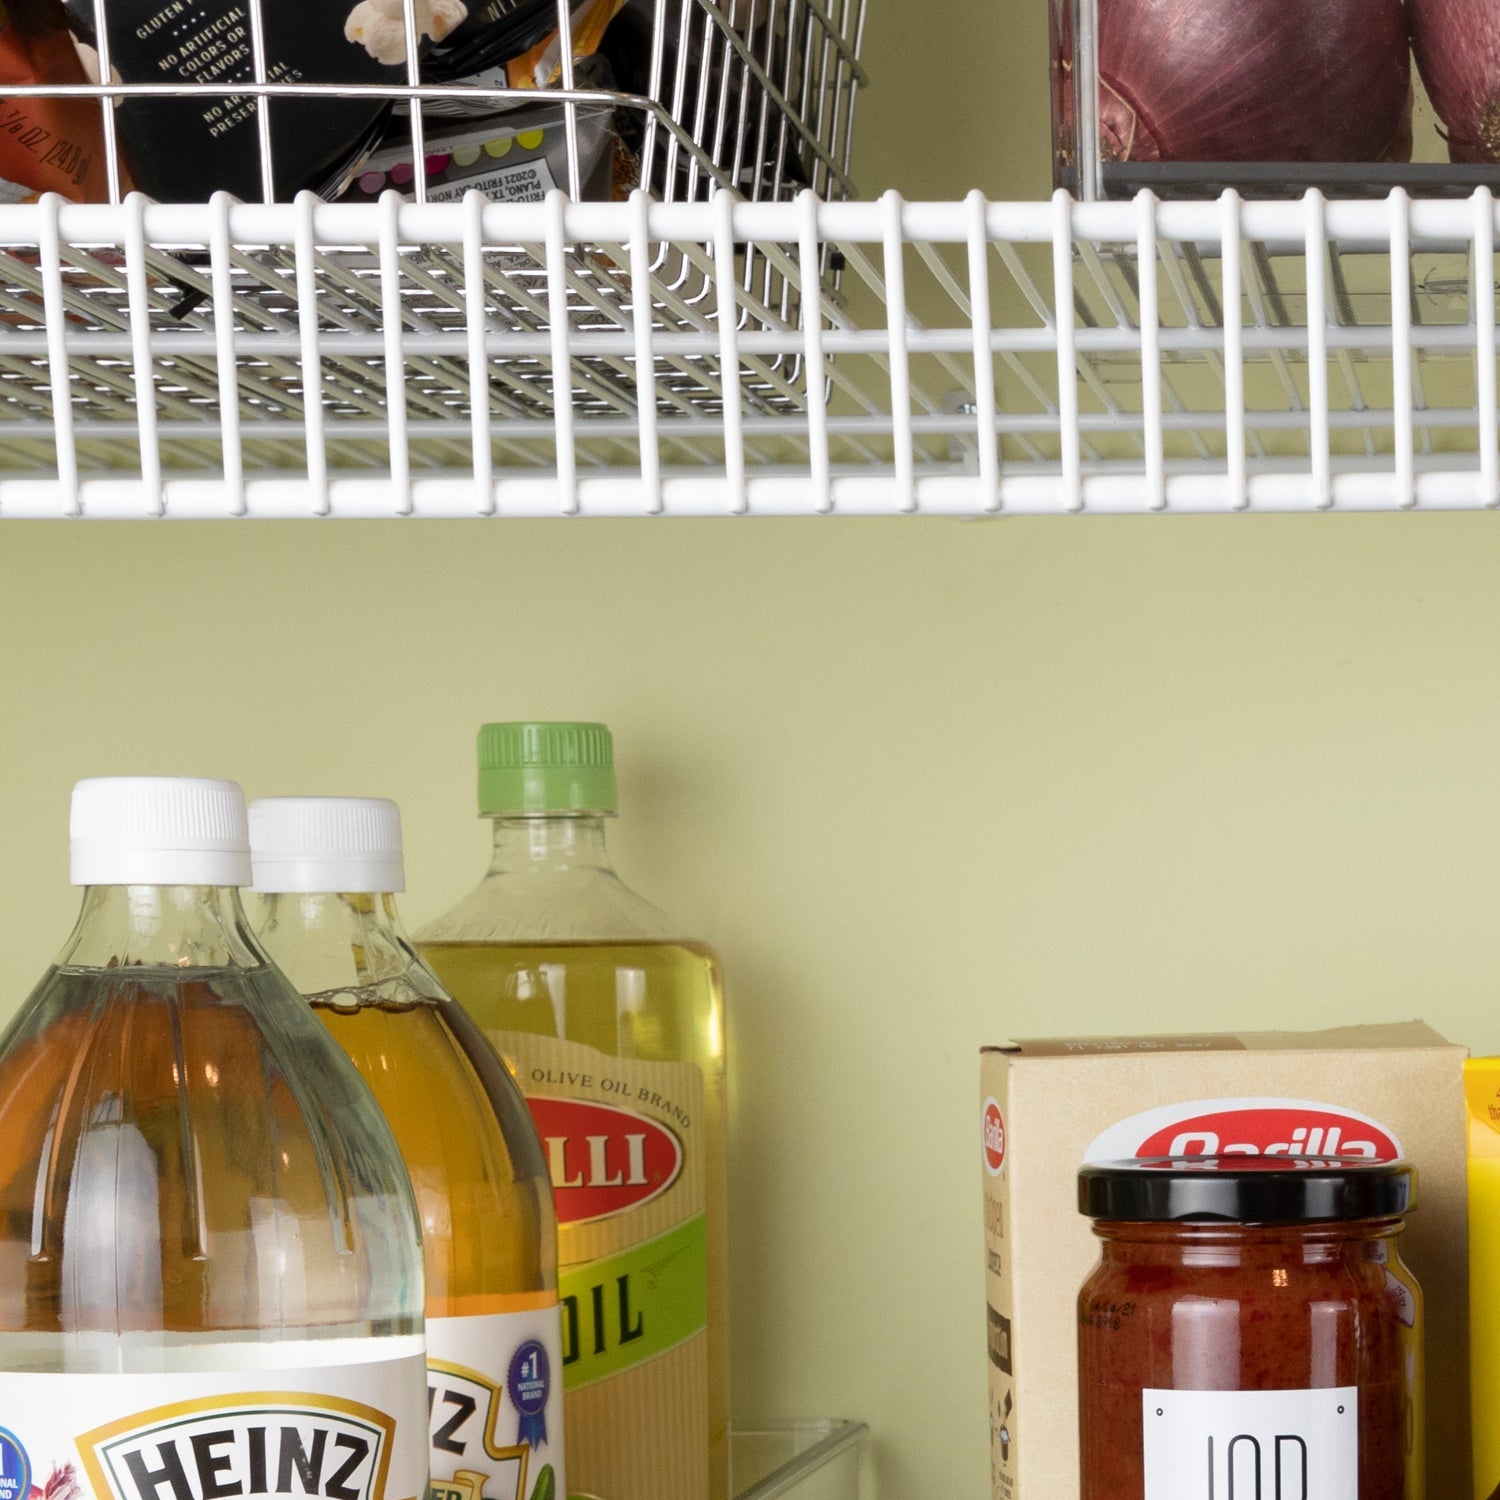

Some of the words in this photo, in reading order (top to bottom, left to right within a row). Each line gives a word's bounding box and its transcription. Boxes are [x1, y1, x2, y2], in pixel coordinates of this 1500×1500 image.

[136, 2, 184, 39] GLUTEN
[158, 54, 178, 71] NO
[179, 7, 246, 58] ARTIFICIAL
[178, 40, 227, 77] COLORS
[227, 26, 246, 43] OR
[196, 43, 250, 83] FLAVORS
[203, 106, 222, 124] NO
[531, 1068, 594, 1088] OLIVE
[600, 1078, 633, 1096] OIL
[637, 1088, 691, 1129] BRAND
